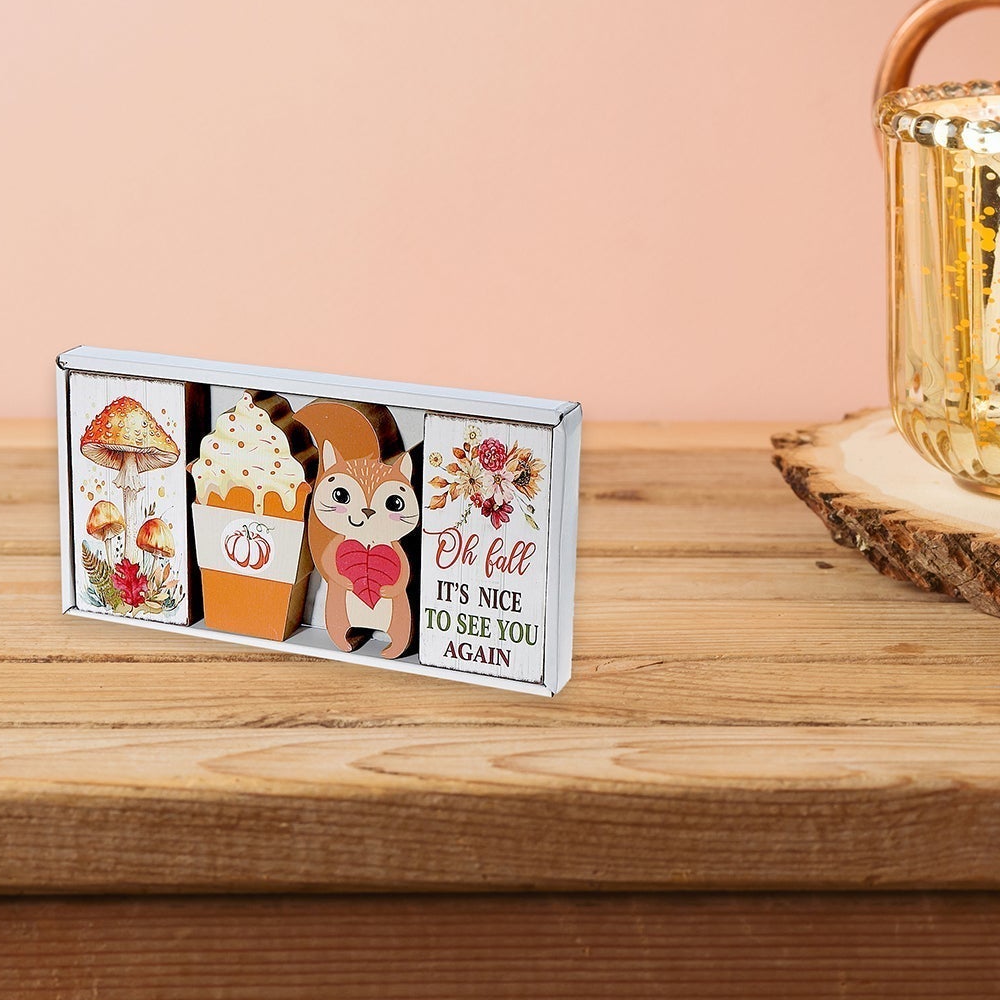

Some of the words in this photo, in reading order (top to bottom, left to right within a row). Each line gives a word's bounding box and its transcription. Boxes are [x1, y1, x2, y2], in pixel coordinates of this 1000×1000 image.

[423, 527, 480, 569] Oh
[485, 537, 536, 578] fall
[436, 580, 469, 605] IT'S
[478, 586, 522, 613] NICE
[425, 608, 451, 631] TO
[456, 612, 491, 639] SEE
[496, 619, 539, 646] YOU
[443, 640, 511, 668] AGAIN
